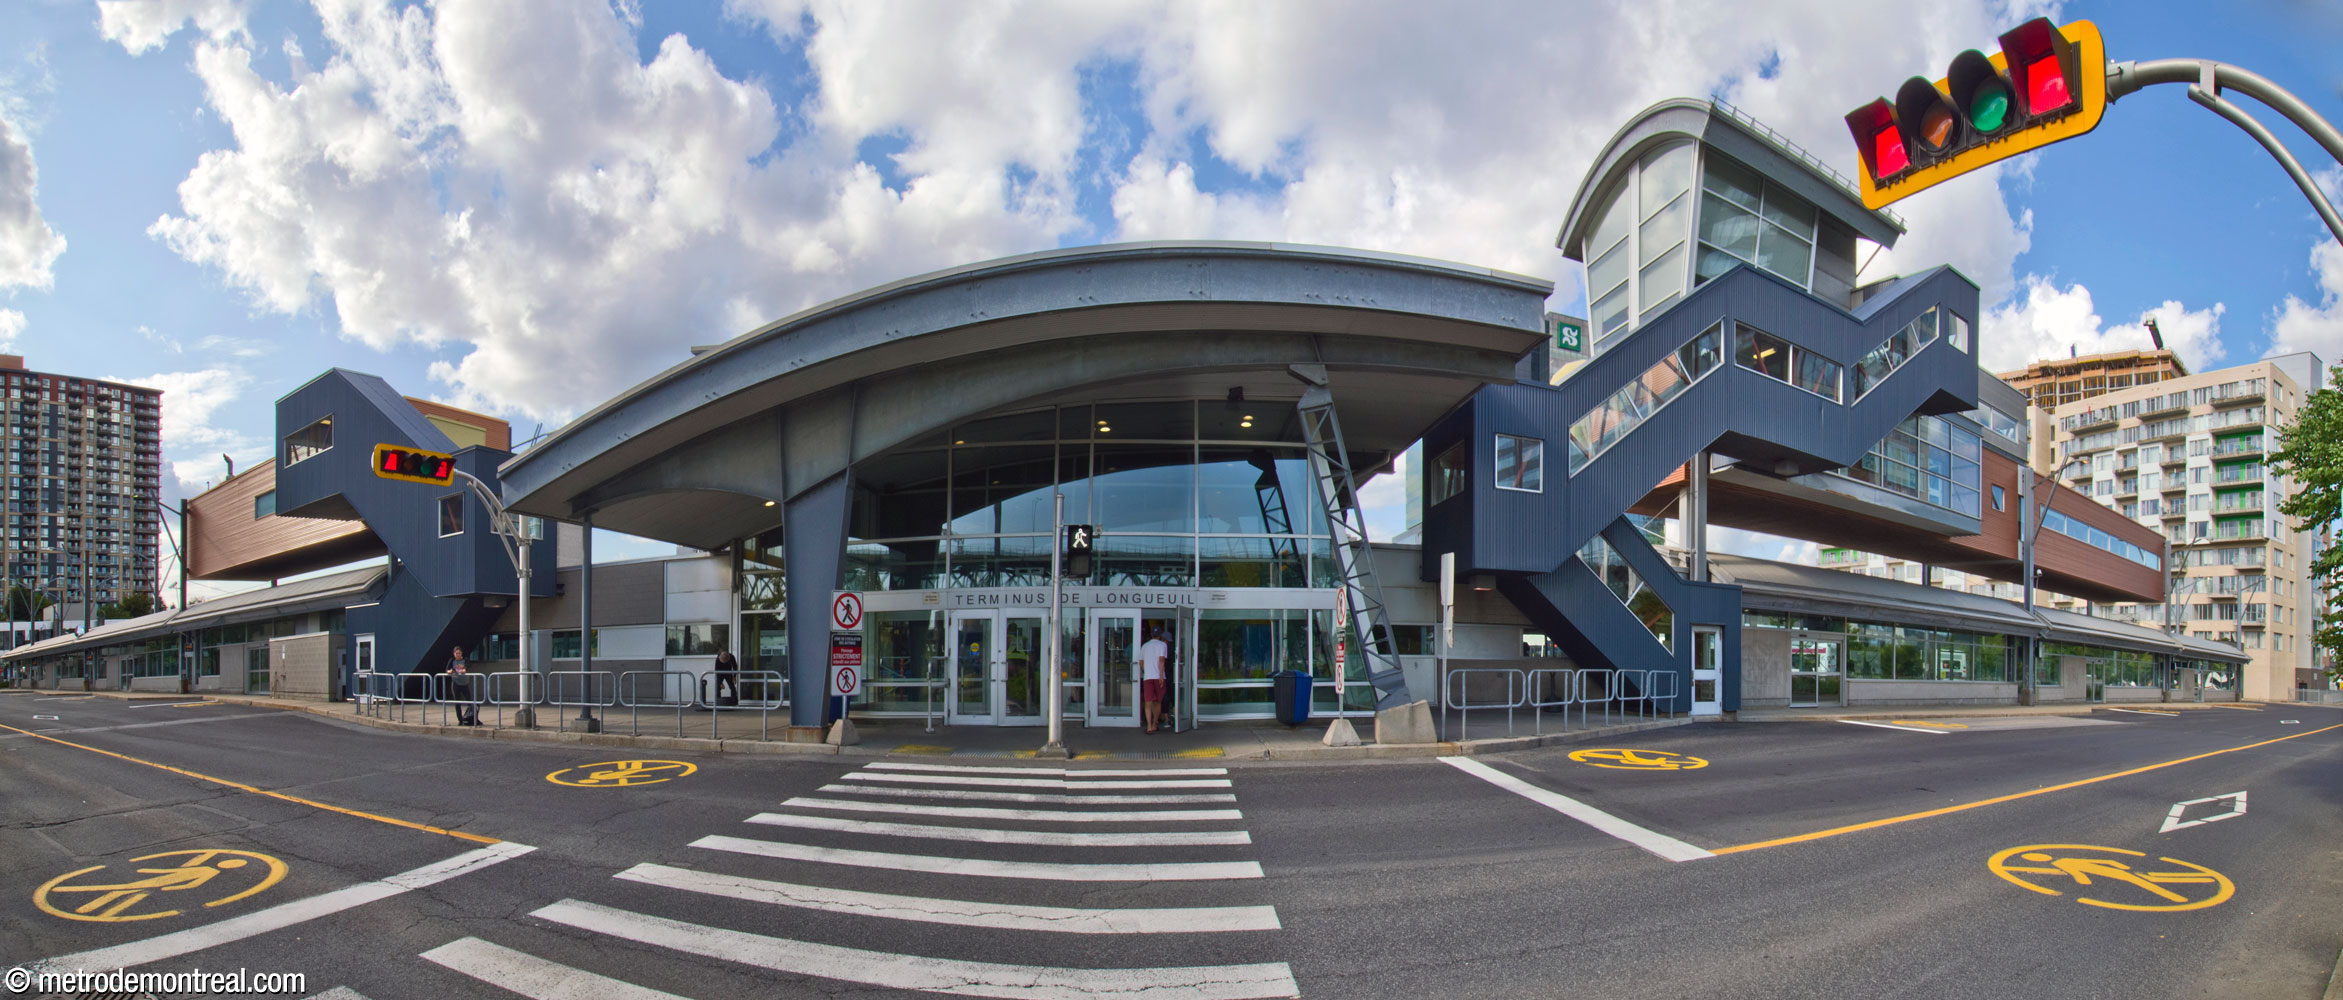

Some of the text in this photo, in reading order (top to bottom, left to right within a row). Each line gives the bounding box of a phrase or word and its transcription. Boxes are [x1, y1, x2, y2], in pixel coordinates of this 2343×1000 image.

[955, 593, 1195, 605] TERMINUS DE LONGUEUIL
